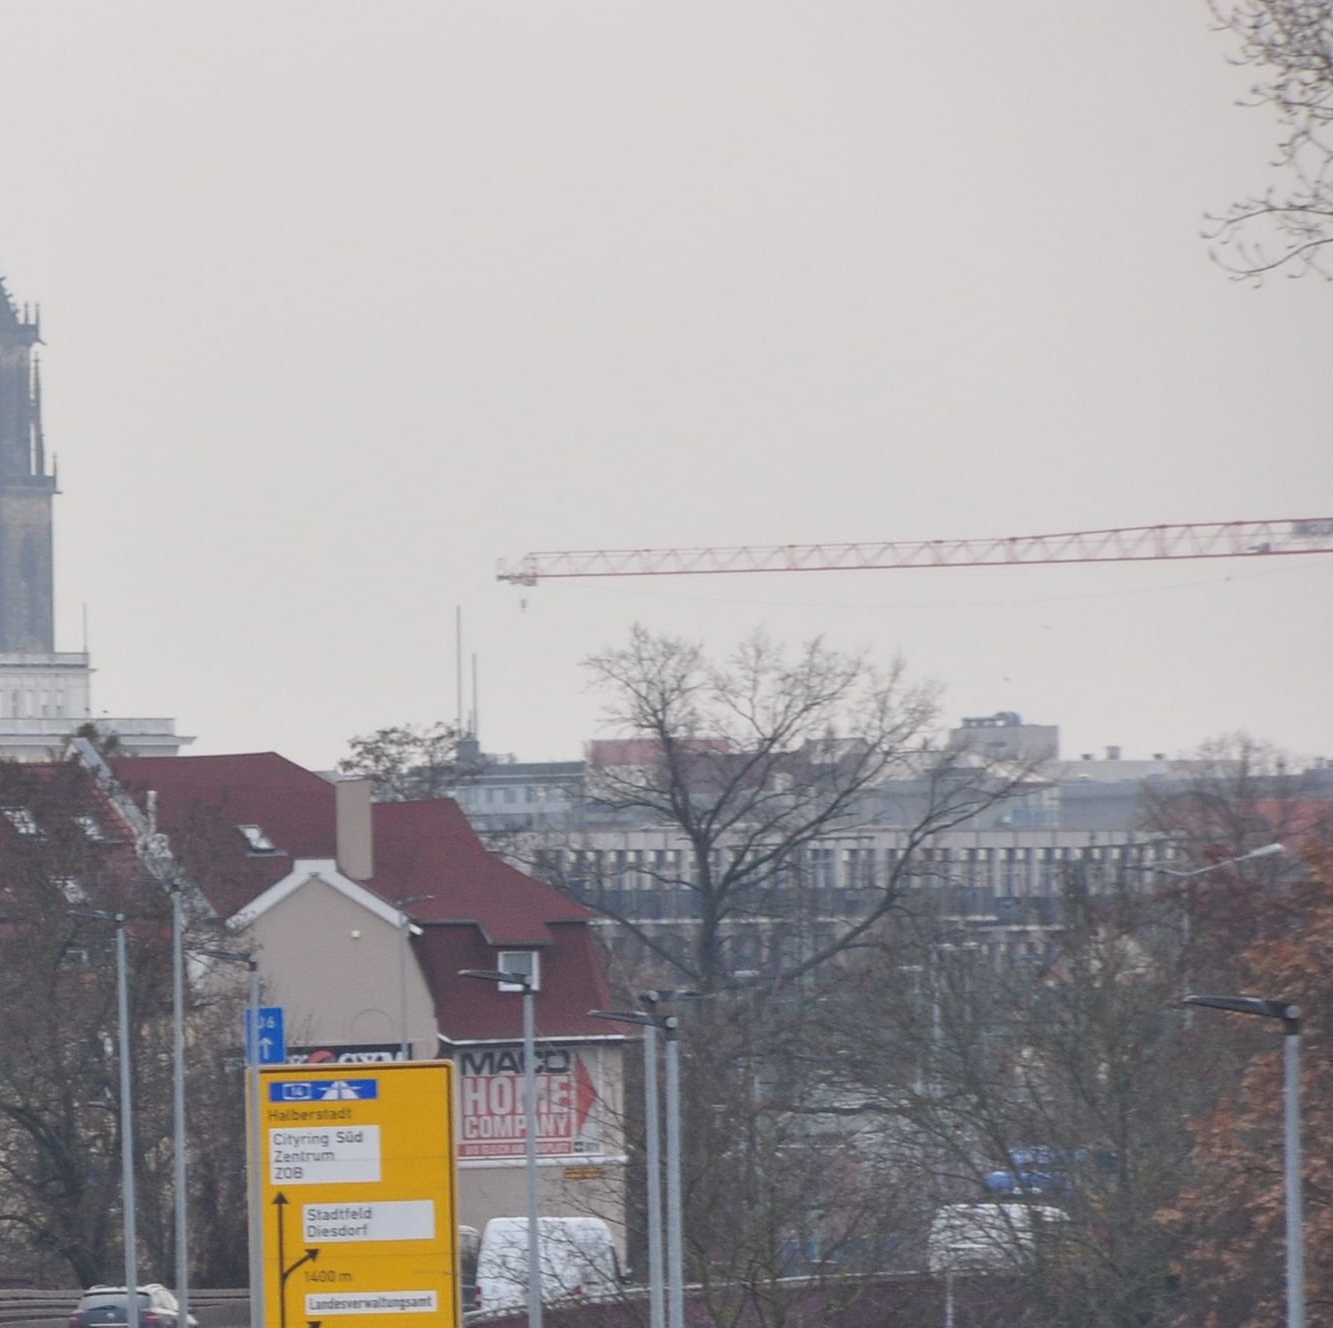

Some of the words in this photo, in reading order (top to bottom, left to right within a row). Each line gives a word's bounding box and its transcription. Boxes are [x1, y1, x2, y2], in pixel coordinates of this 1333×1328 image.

[464, 1076, 570, 1115] HOME
[269, 1108, 351, 1121] Halberstadt
[465, 1114, 569, 1139] COMPNY
[273, 1132, 329, 1147] Cityring
[336, 1131, 363, 1143] Süd
[274, 1151, 335, 1163] Zentrum
[275, 1167, 303, 1179] ZOB
[307, 1208, 372, 1221] Stadtfeld
[307, 1224, 368, 1238] Diesdorf
[305, 1270, 335, 1283] 1400
[339, 1272, 352, 1282] m
[309, 1296, 432, 1311] Landesverwaltungsamt
